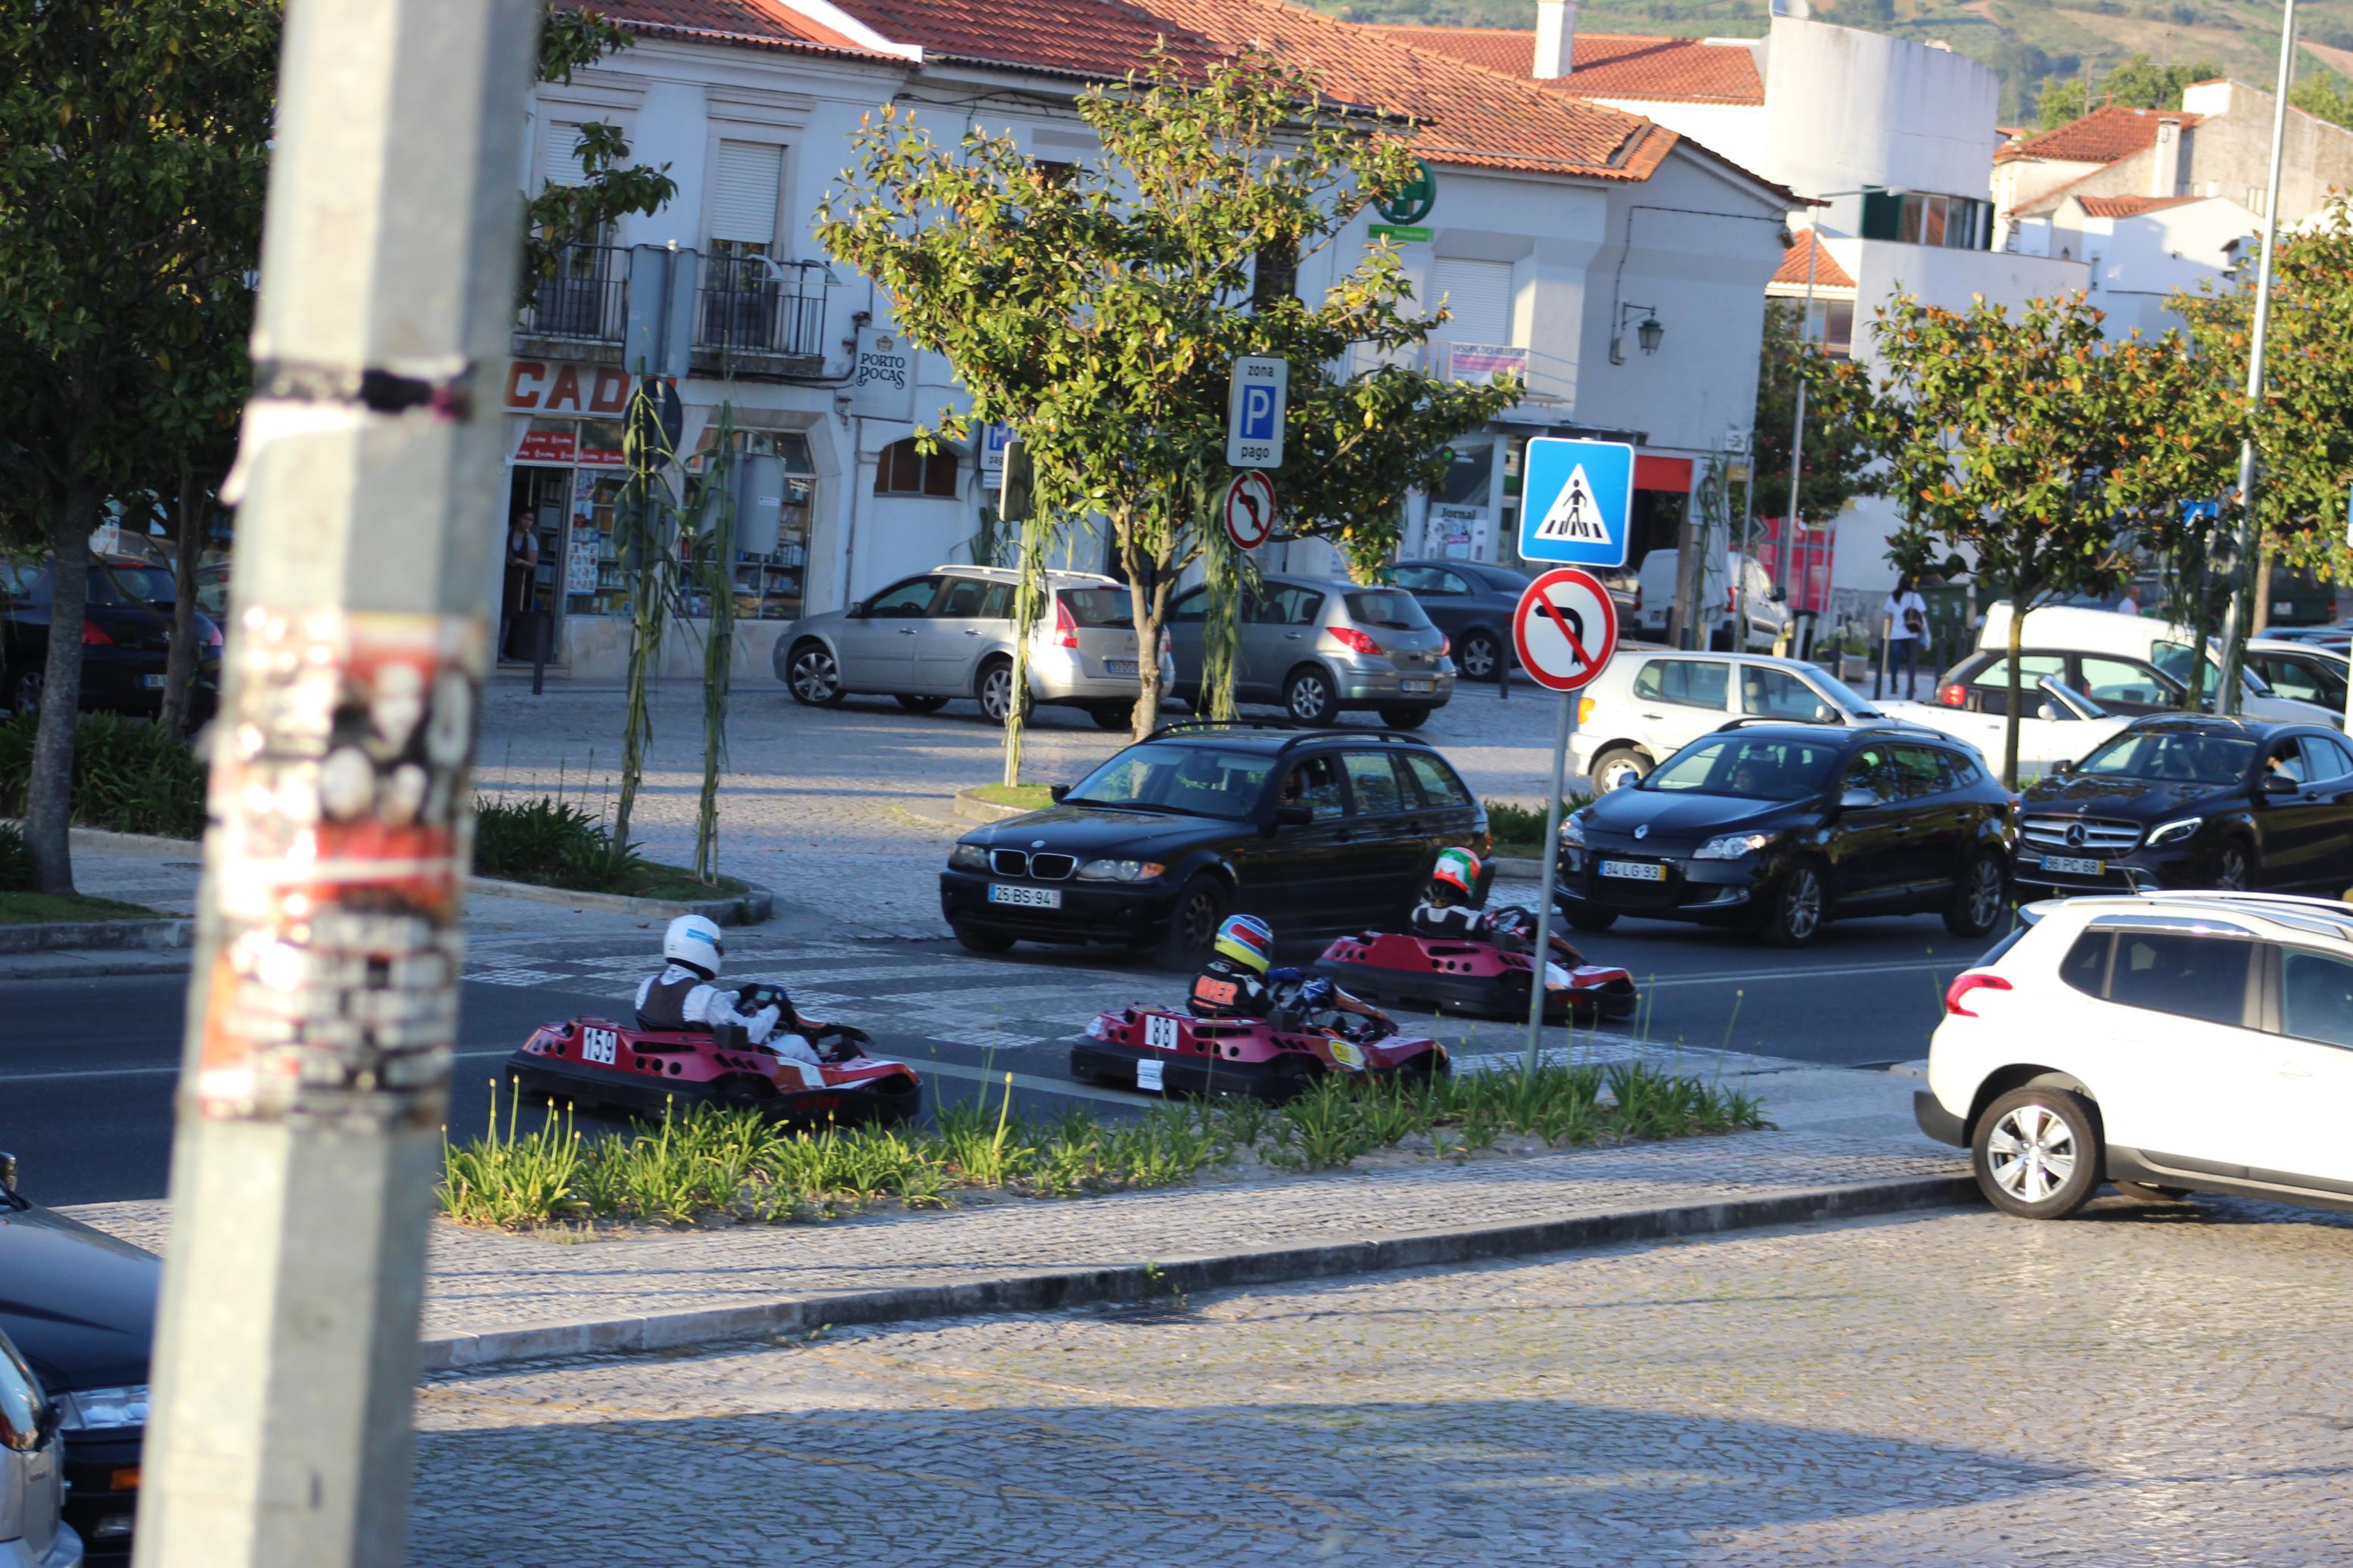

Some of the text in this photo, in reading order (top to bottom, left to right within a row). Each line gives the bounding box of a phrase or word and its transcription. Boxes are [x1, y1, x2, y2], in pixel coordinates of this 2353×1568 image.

[860, 352, 905, 368] PORTO
[1248, 365, 1274, 377] zona
[504, 362, 677, 413] CAD
[1245, 389, 1270, 435] P
[1241, 446, 1270, 461] pago
[1441, 508, 1477, 520] Jornal
[1153, 1017, 1171, 1048] 88
[587, 1029, 613, 1062] 159
